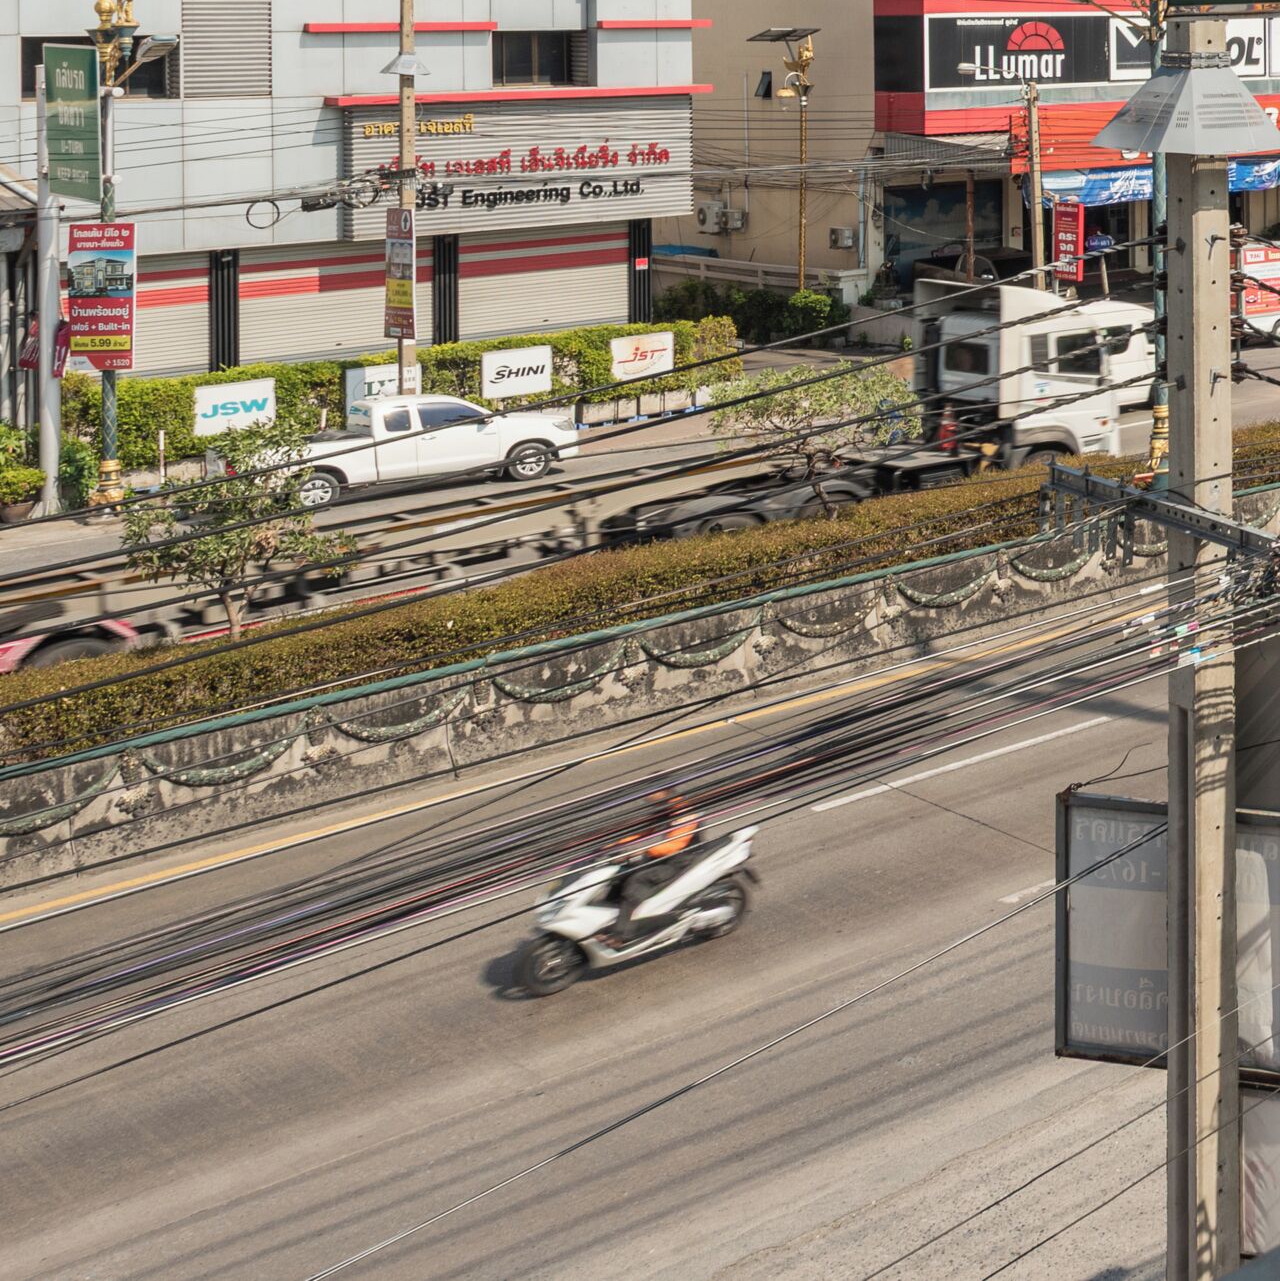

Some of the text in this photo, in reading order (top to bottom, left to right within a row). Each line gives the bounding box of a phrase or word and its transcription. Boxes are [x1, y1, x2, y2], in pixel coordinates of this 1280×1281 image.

[974, 45, 1066, 81] LLumar
[55, 62, 85, 91] กลับรถ
[60, 139, 84, 155] U-TURN
[444, 148, 512, 177] เจเอสที
[627, 142, 670, 166] จำกัด
[461, 184, 571, 209] Engineering
[71, 304, 130, 319] บ้านพร้อมอยู่
[98, 322, 130, 332] Built-in
[90, 337, 112, 349] 5.99
[112, 358, 130, 366] 1520
[489, 364, 546, 384] SHINI
[201, 397, 269, 419] JSW
